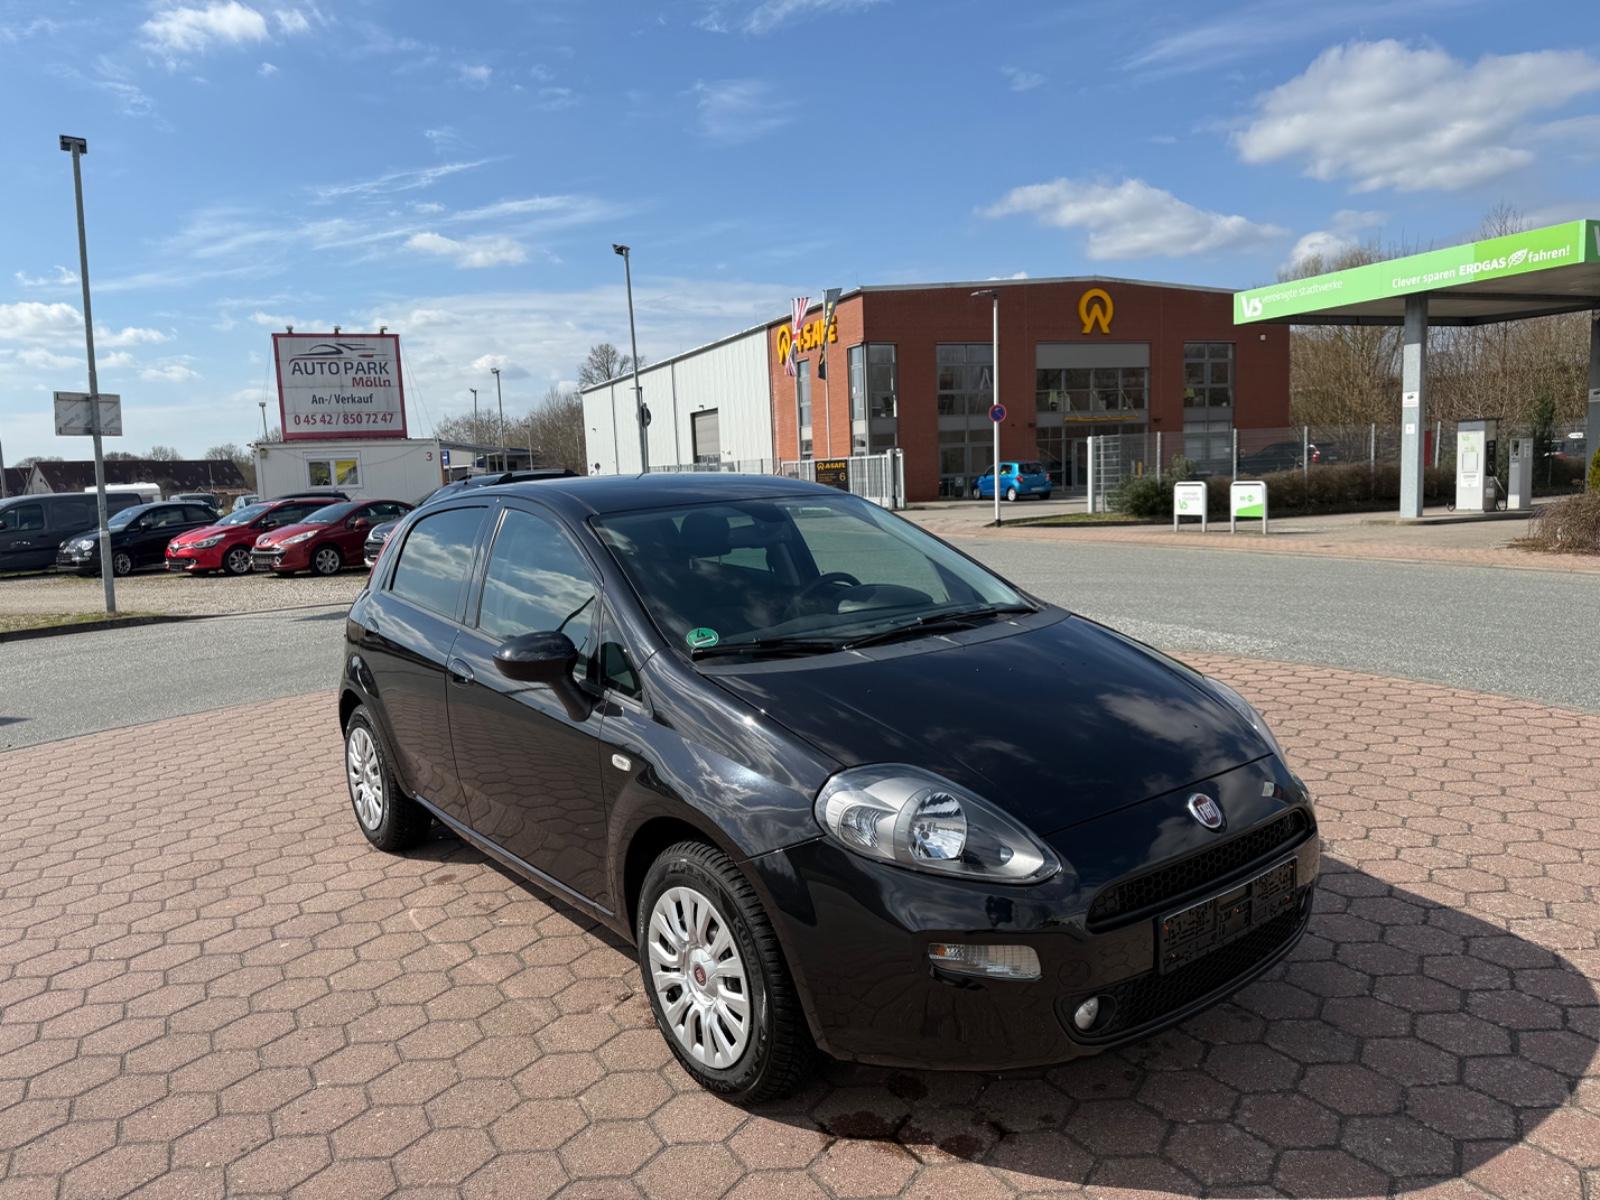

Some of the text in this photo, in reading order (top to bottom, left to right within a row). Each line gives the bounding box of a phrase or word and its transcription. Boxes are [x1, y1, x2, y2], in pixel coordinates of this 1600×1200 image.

[1392, 244, 1570, 289] Clever sparen ERDGAS fahren!
[1298, 280, 1343, 297] stadtwerke
[291, 360, 390, 376] AUTO PARK
[352, 376, 391, 388] Mölln
[334, 393, 374, 405] Verkauf
[294, 414, 301, 425] 0
[303, 414, 317, 425] 45
[319, 414, 333, 425] 42
[342, 413, 363, 425] 850
[365, 412, 379, 424] 72
[380, 412, 394, 424] 47
[426, 451, 433, 461] 3
[839, 472, 846, 481] 6
